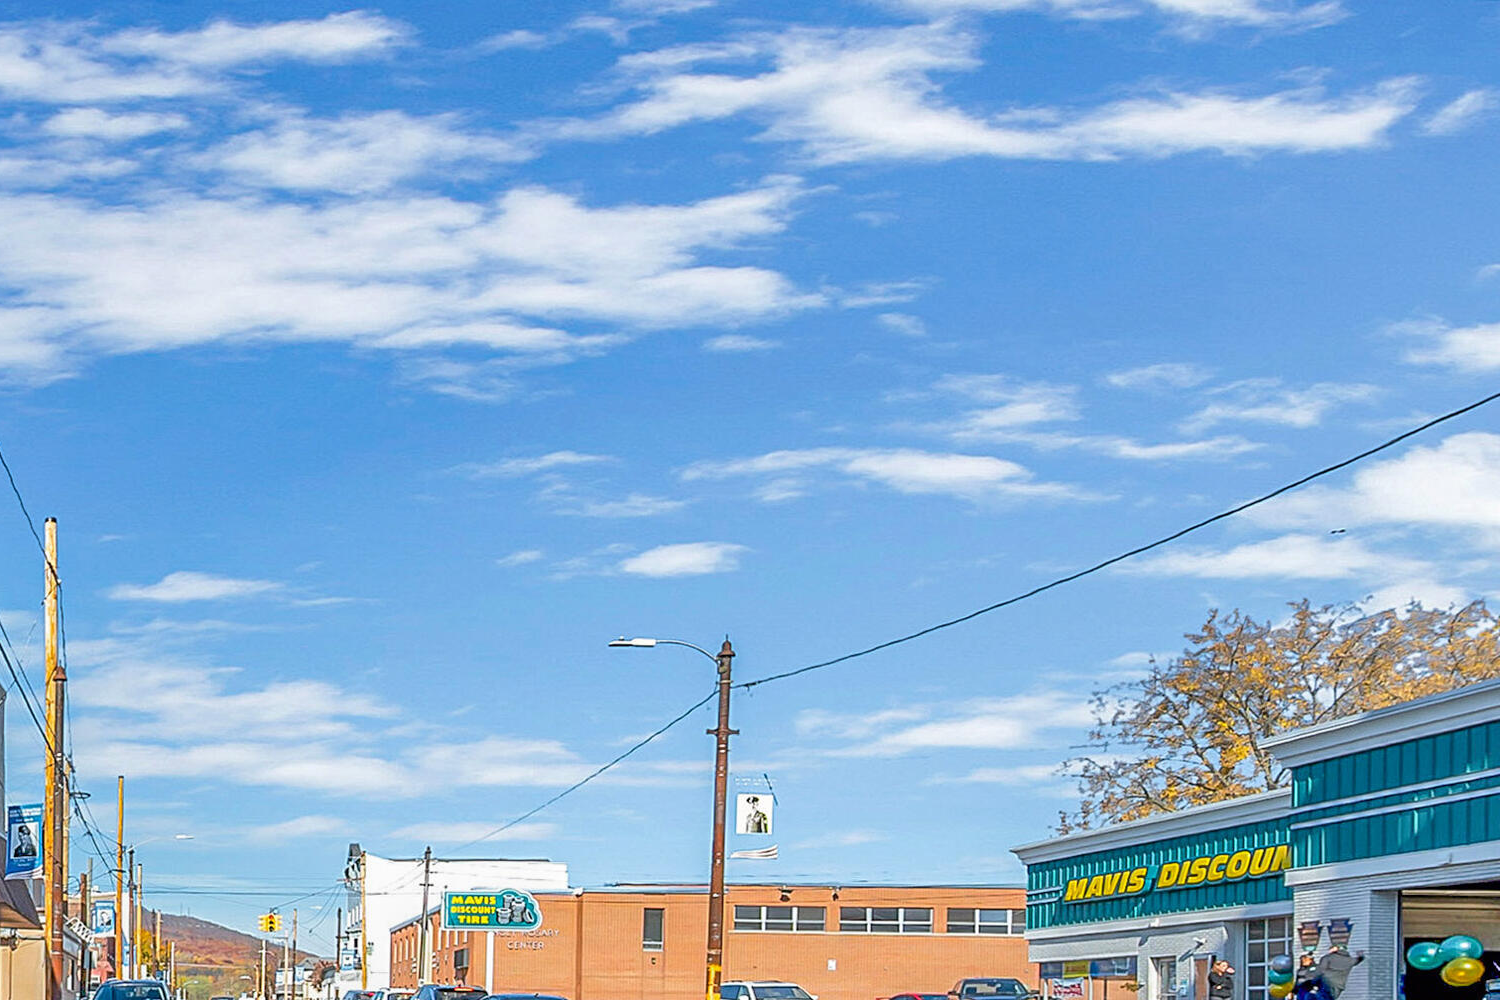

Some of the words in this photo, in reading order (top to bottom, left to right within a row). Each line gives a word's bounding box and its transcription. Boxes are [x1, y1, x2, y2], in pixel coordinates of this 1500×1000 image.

[1065, 867, 1147, 901] MAVIS
[451, 896, 496, 905] MAVIS
[450, 906, 496, 914] DISCOUNT
[457, 915, 489, 924] TIRE
[507, 941, 544, 950] CENTER
